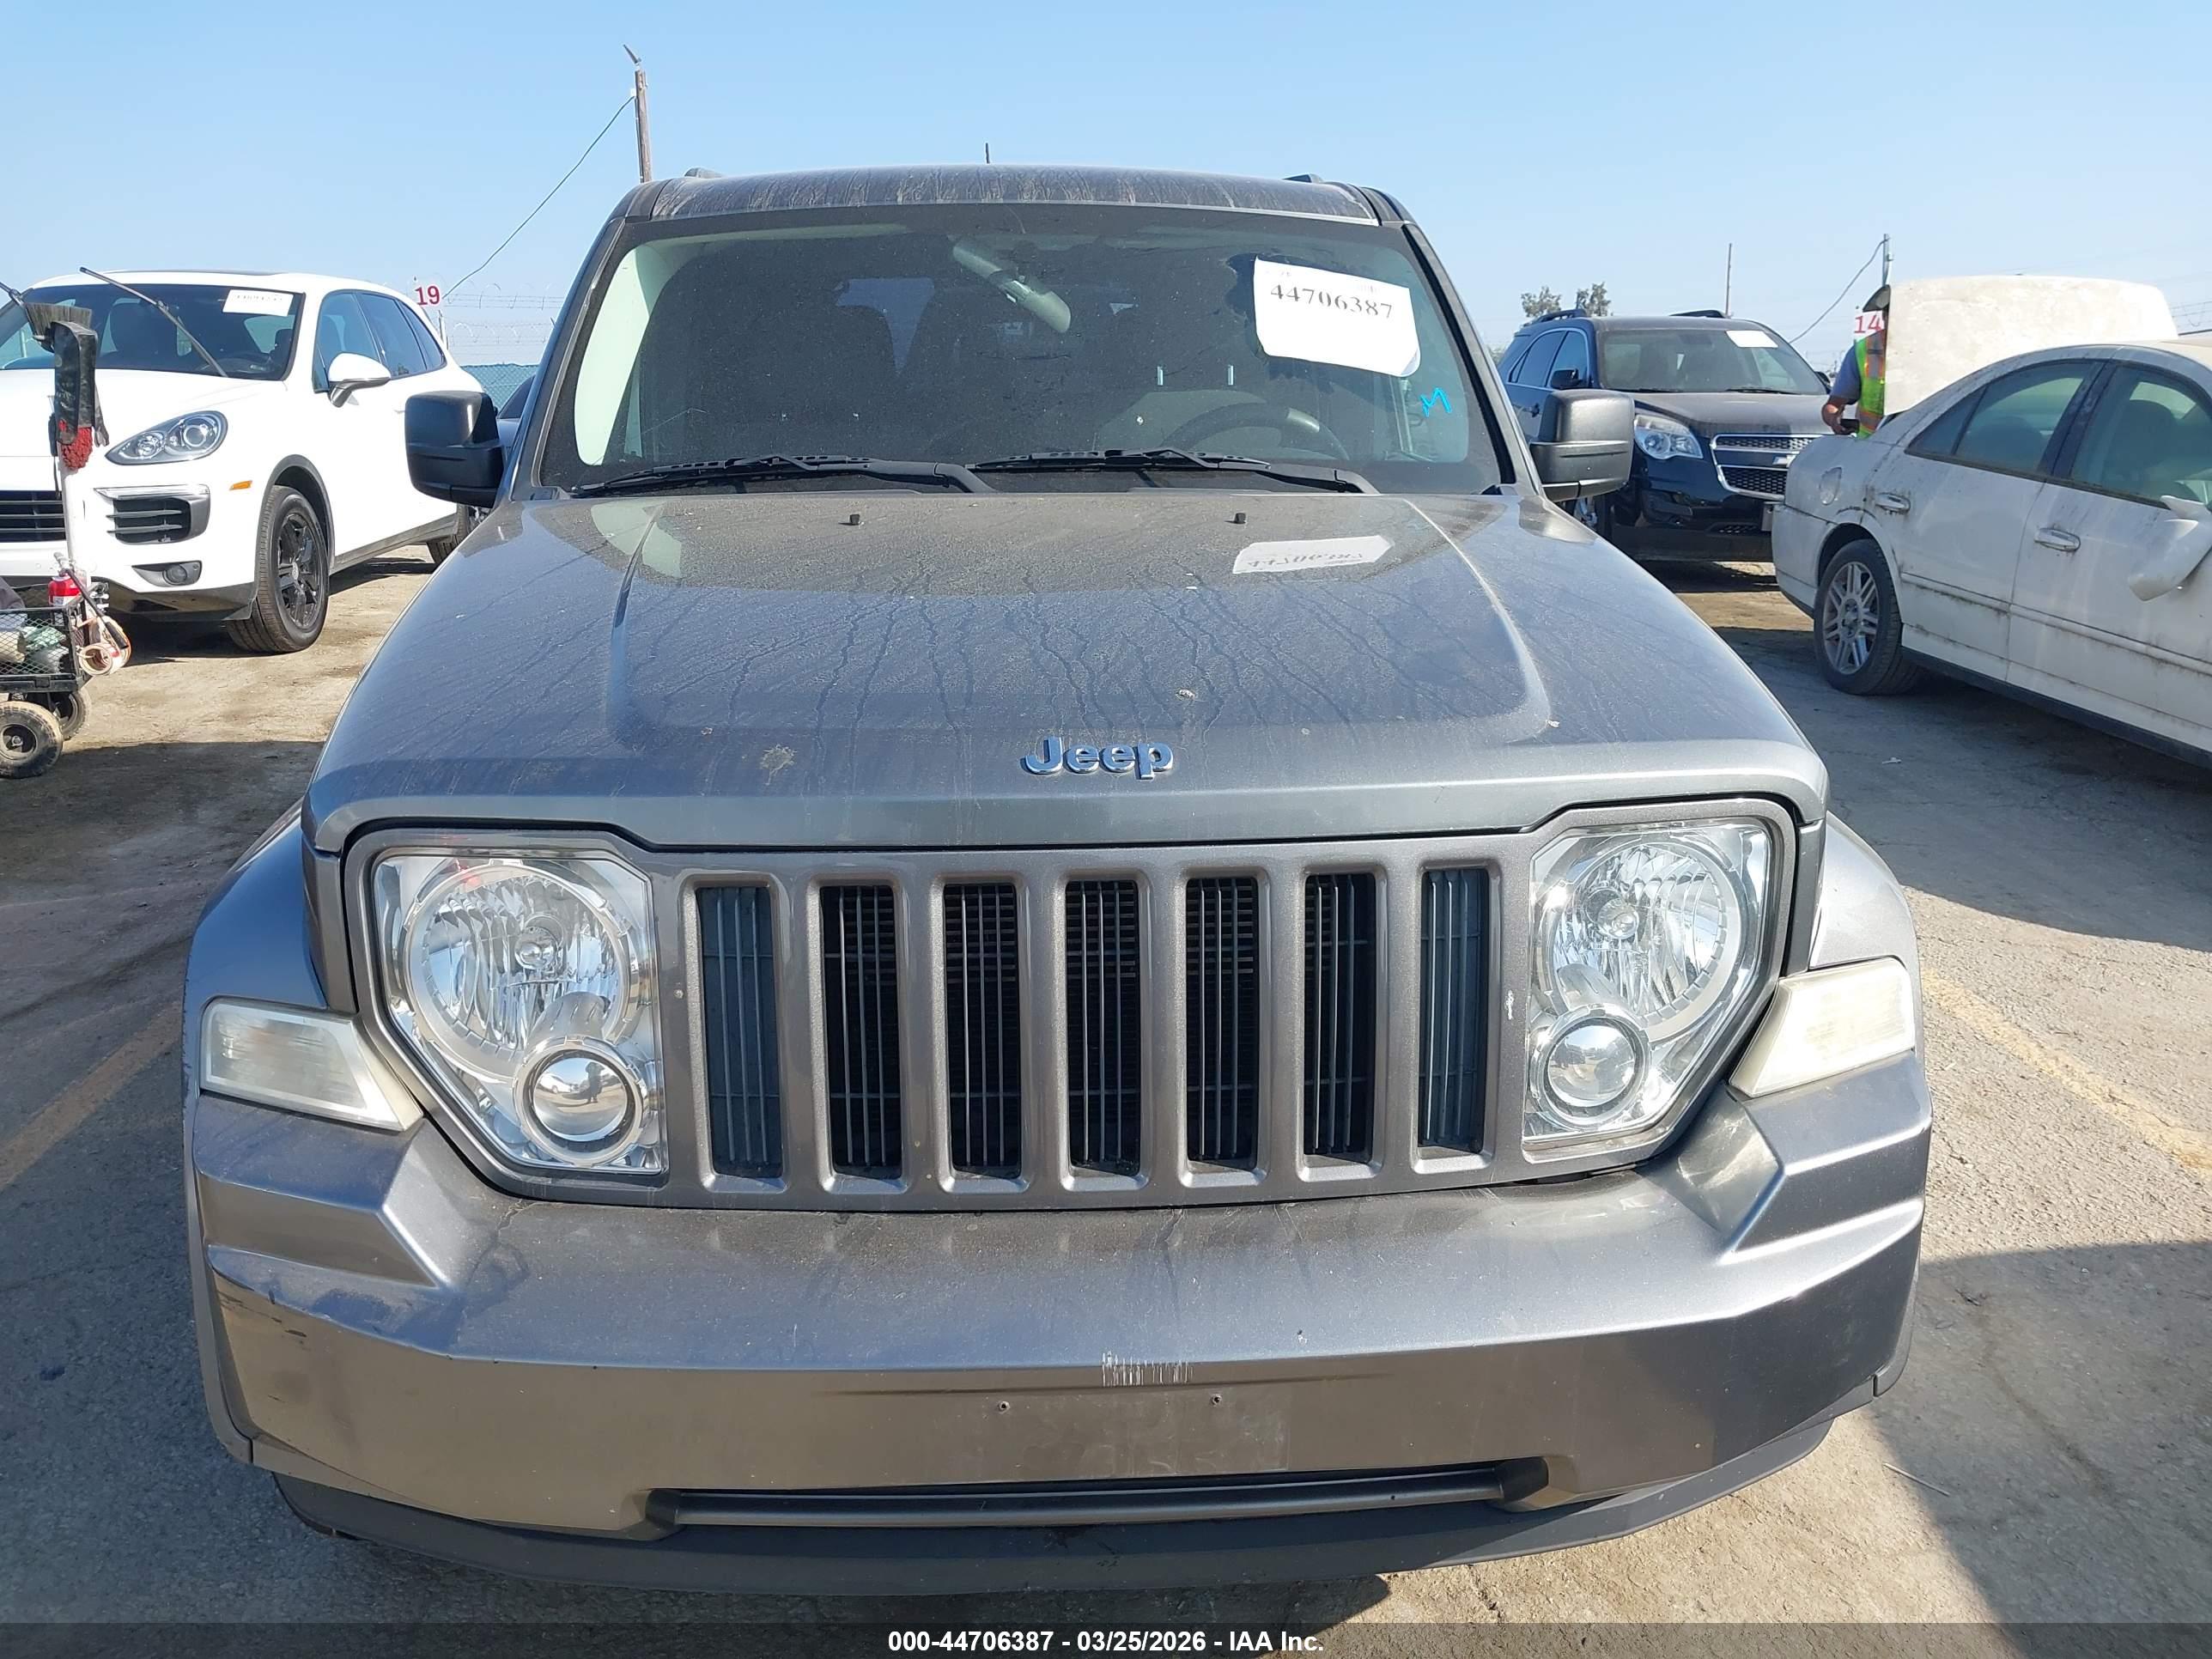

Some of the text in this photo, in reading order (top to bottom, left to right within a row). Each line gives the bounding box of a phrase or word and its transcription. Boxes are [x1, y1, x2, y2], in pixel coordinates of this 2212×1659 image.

[415, 285, 441, 306] 19
[1270, 284, 1393, 319] 44706387
[1853, 313, 1883, 334] 14
[1022, 736, 1174, 779] Jeep
